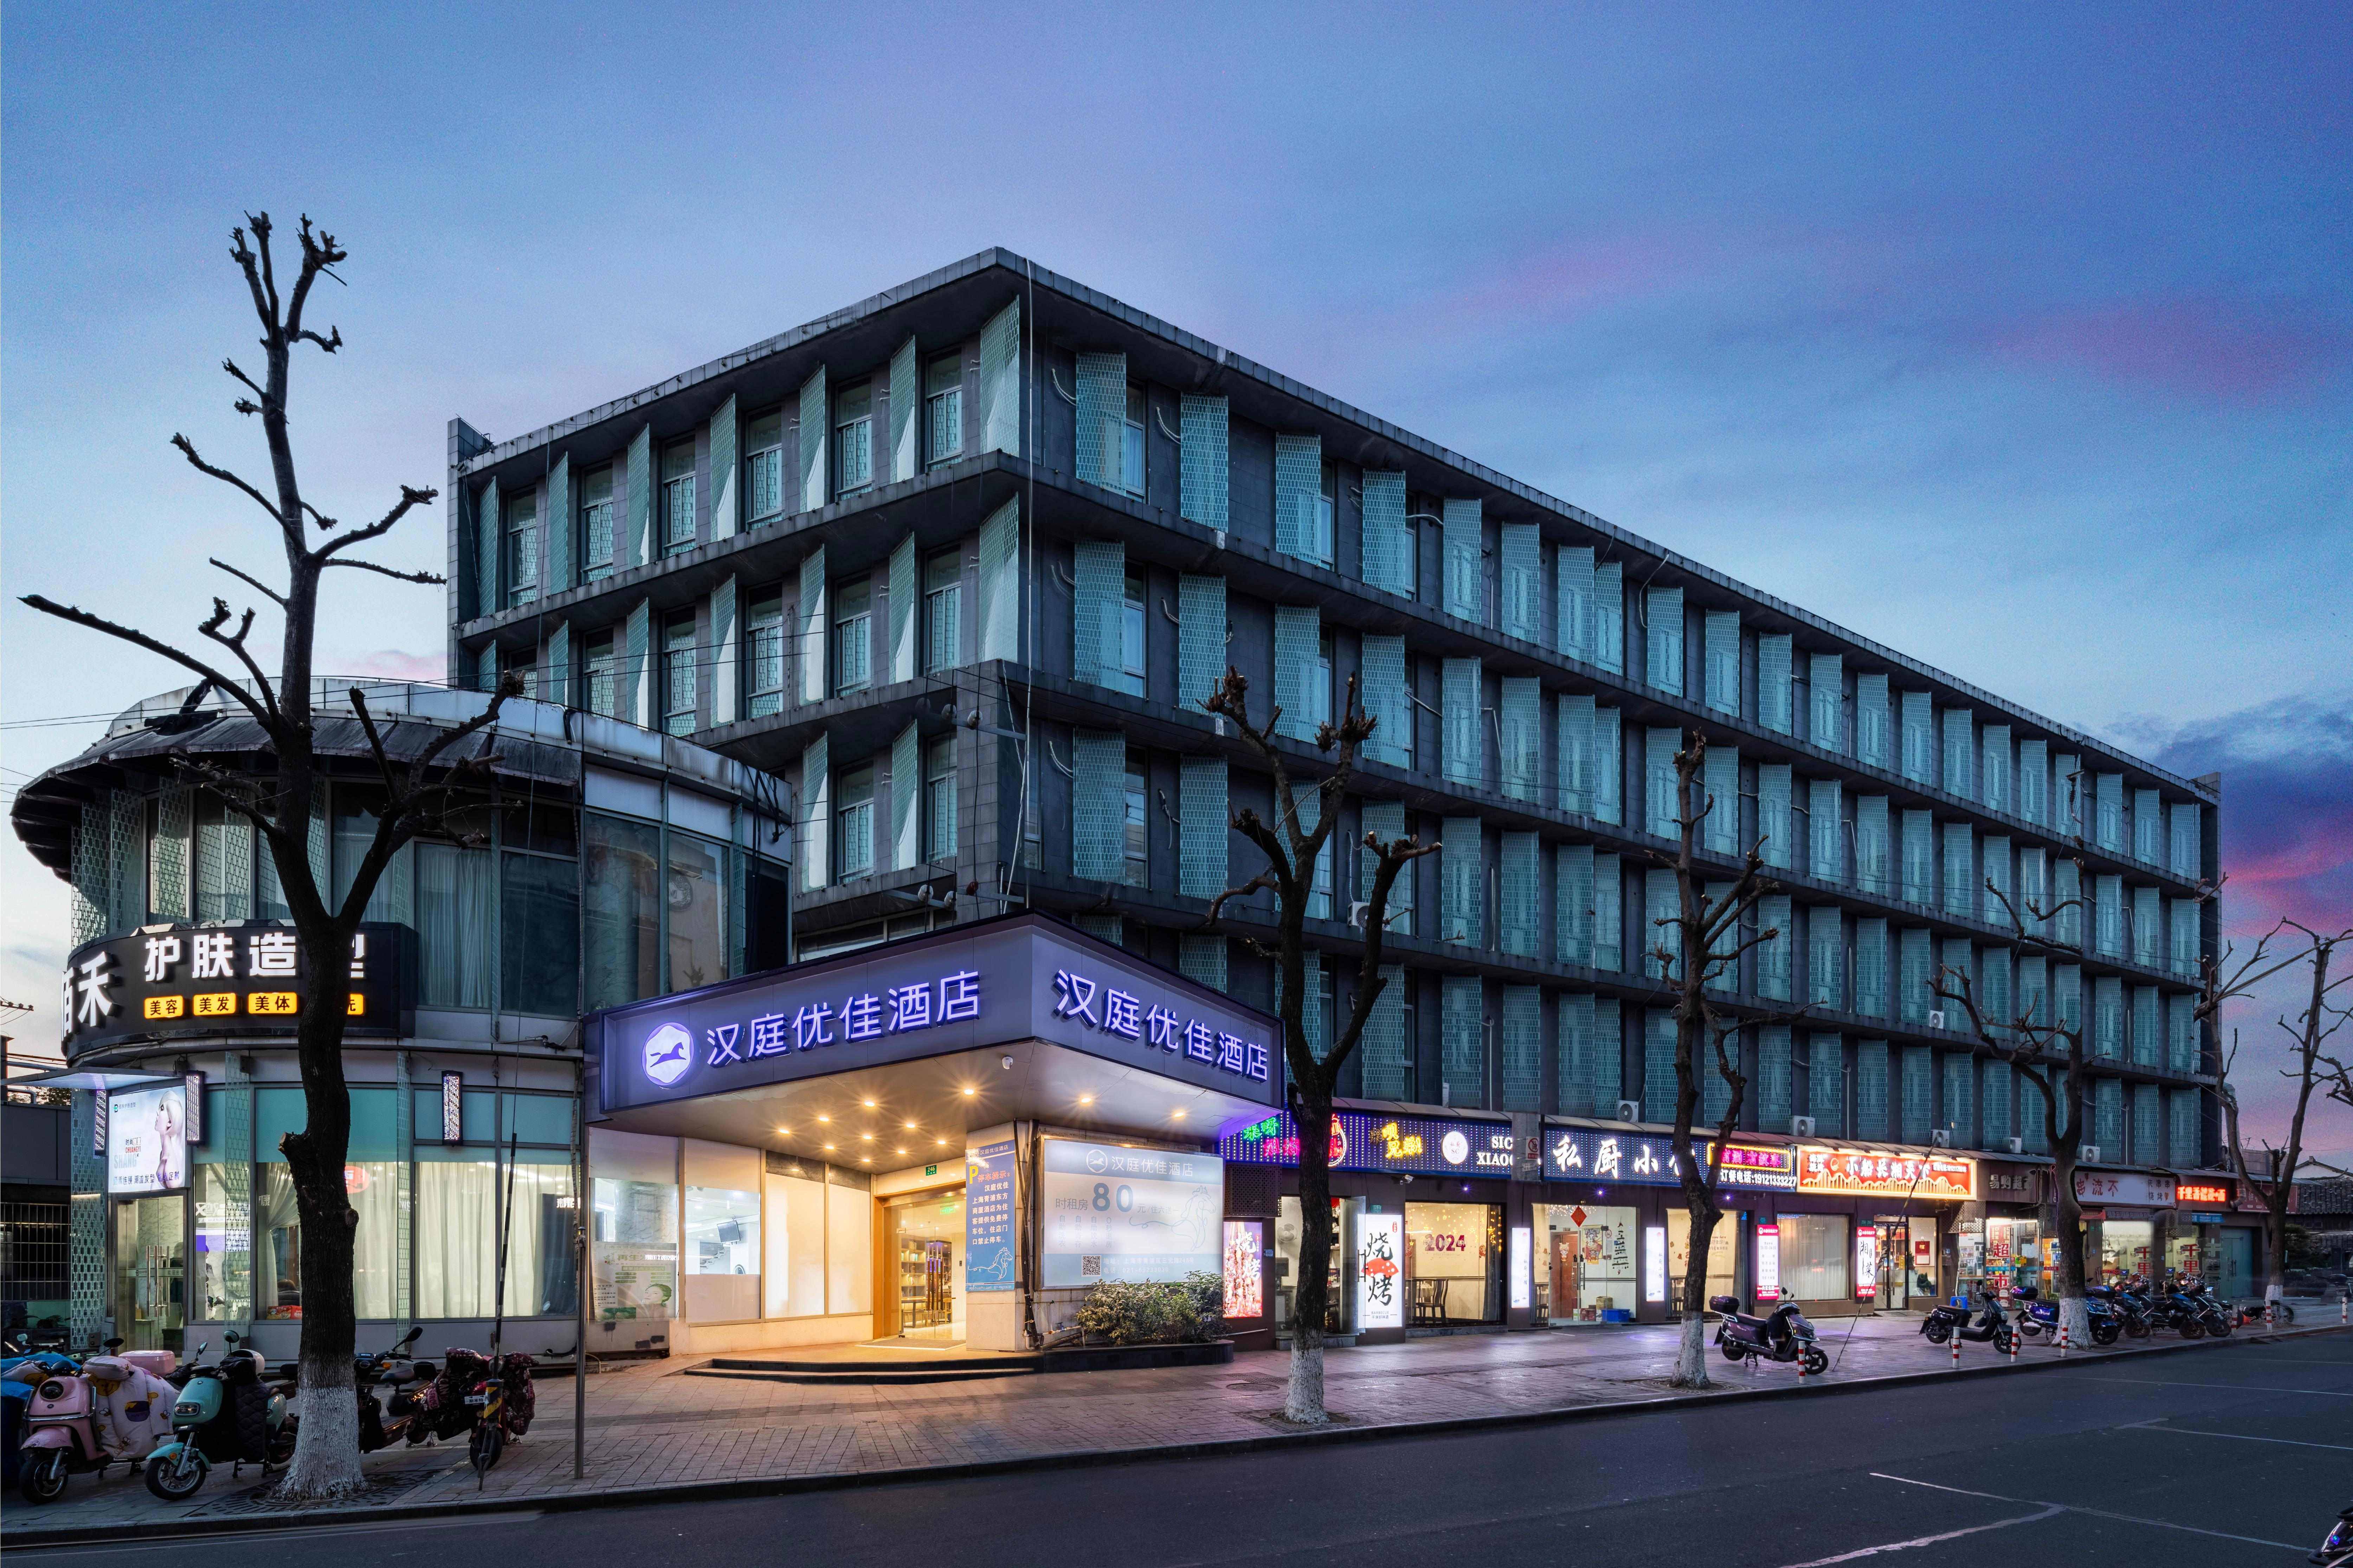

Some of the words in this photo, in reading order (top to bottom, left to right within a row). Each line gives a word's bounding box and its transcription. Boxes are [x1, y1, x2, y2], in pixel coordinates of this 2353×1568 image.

[150, 999, 178, 1016] 美容
[199, 996, 230, 1012] 美发
[255, 995, 290, 1011] 美体
[705, 970, 980, 1067] 汉庭优佳酒店
[1055, 968, 1268, 1083] 汉庭优佳酒店
[980, 1145, 1008, 1155] 汉庭优佳酒店
[1491, 1136, 1513, 1149] SIC
[969, 1166, 979, 1184] P
[1111, 1156, 1193, 1177] 汉庭优佳酒店
[985, 1181, 1009, 1192] 汉庭优佳
[972, 1192, 1008, 1204] 上海青浦东方
[1055, 1198, 1088, 1211] 时租房
[1092, 1183, 1134, 1212] 80
[972, 1203, 1008, 1214] 商厦酒店为住
[972, 1214, 1008, 1225] 客提供免费停
[1425, 1234, 1466, 1251] 2024
[1235, 1231, 1262, 1281] 烧烤
[2182, 1243, 2201, 1274] 千里
[1367, 1232, 1393, 1306] 烧烤
[1993, 1243, 2010, 1289] 超市
